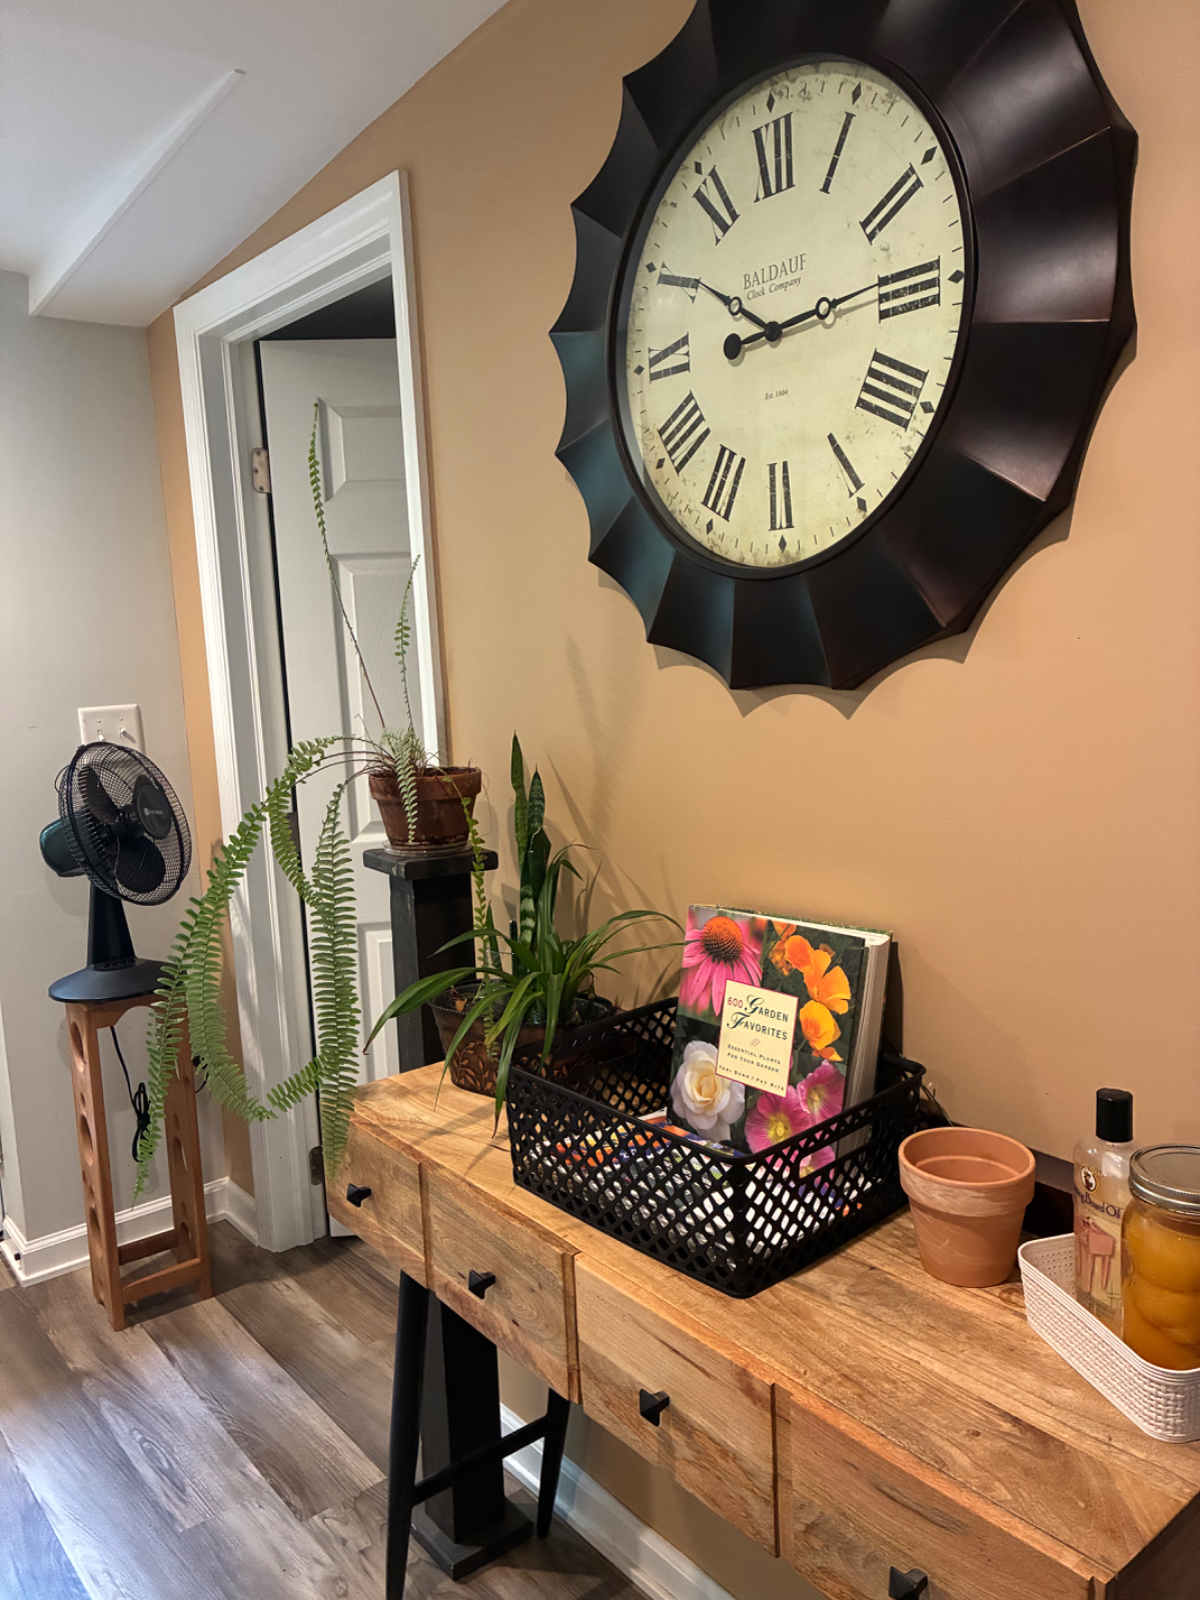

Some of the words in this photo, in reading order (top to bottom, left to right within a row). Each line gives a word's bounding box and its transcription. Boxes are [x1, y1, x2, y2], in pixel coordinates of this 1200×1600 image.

[751, 111, 796, 203] XII
[818, 111, 856, 194] I
[691, 164, 741, 247] XI
[859, 163, 925, 245] II
[656, 260, 702, 304] X
[742, 252, 807, 290] BALDAUF
[746, 286, 766, 300] Clock
[768, 276, 802, 293] Company
[878, 256, 941, 324] III
[647, 331, 691, 384] IX
[855, 348, 929, 432] IIII
[657, 389, 711, 477] VIII
[826, 432, 866, 499] V
[700, 443, 746, 522] VII
[768, 460, 795, 532] VI
[726, 1011, 788, 1041] FAVORITES
[727, 996, 744, 1009] 600
[744, 994, 789, 1023] GARDEN
[727, 1043, 757, 1058] ESSENTIAL
[759, 1053, 781, 1065] PLANTS
[727, 1052, 738, 1060] FOR
[740, 1056, 755, 1065] YOUR
[756, 1061, 780, 1073] GARDEN
